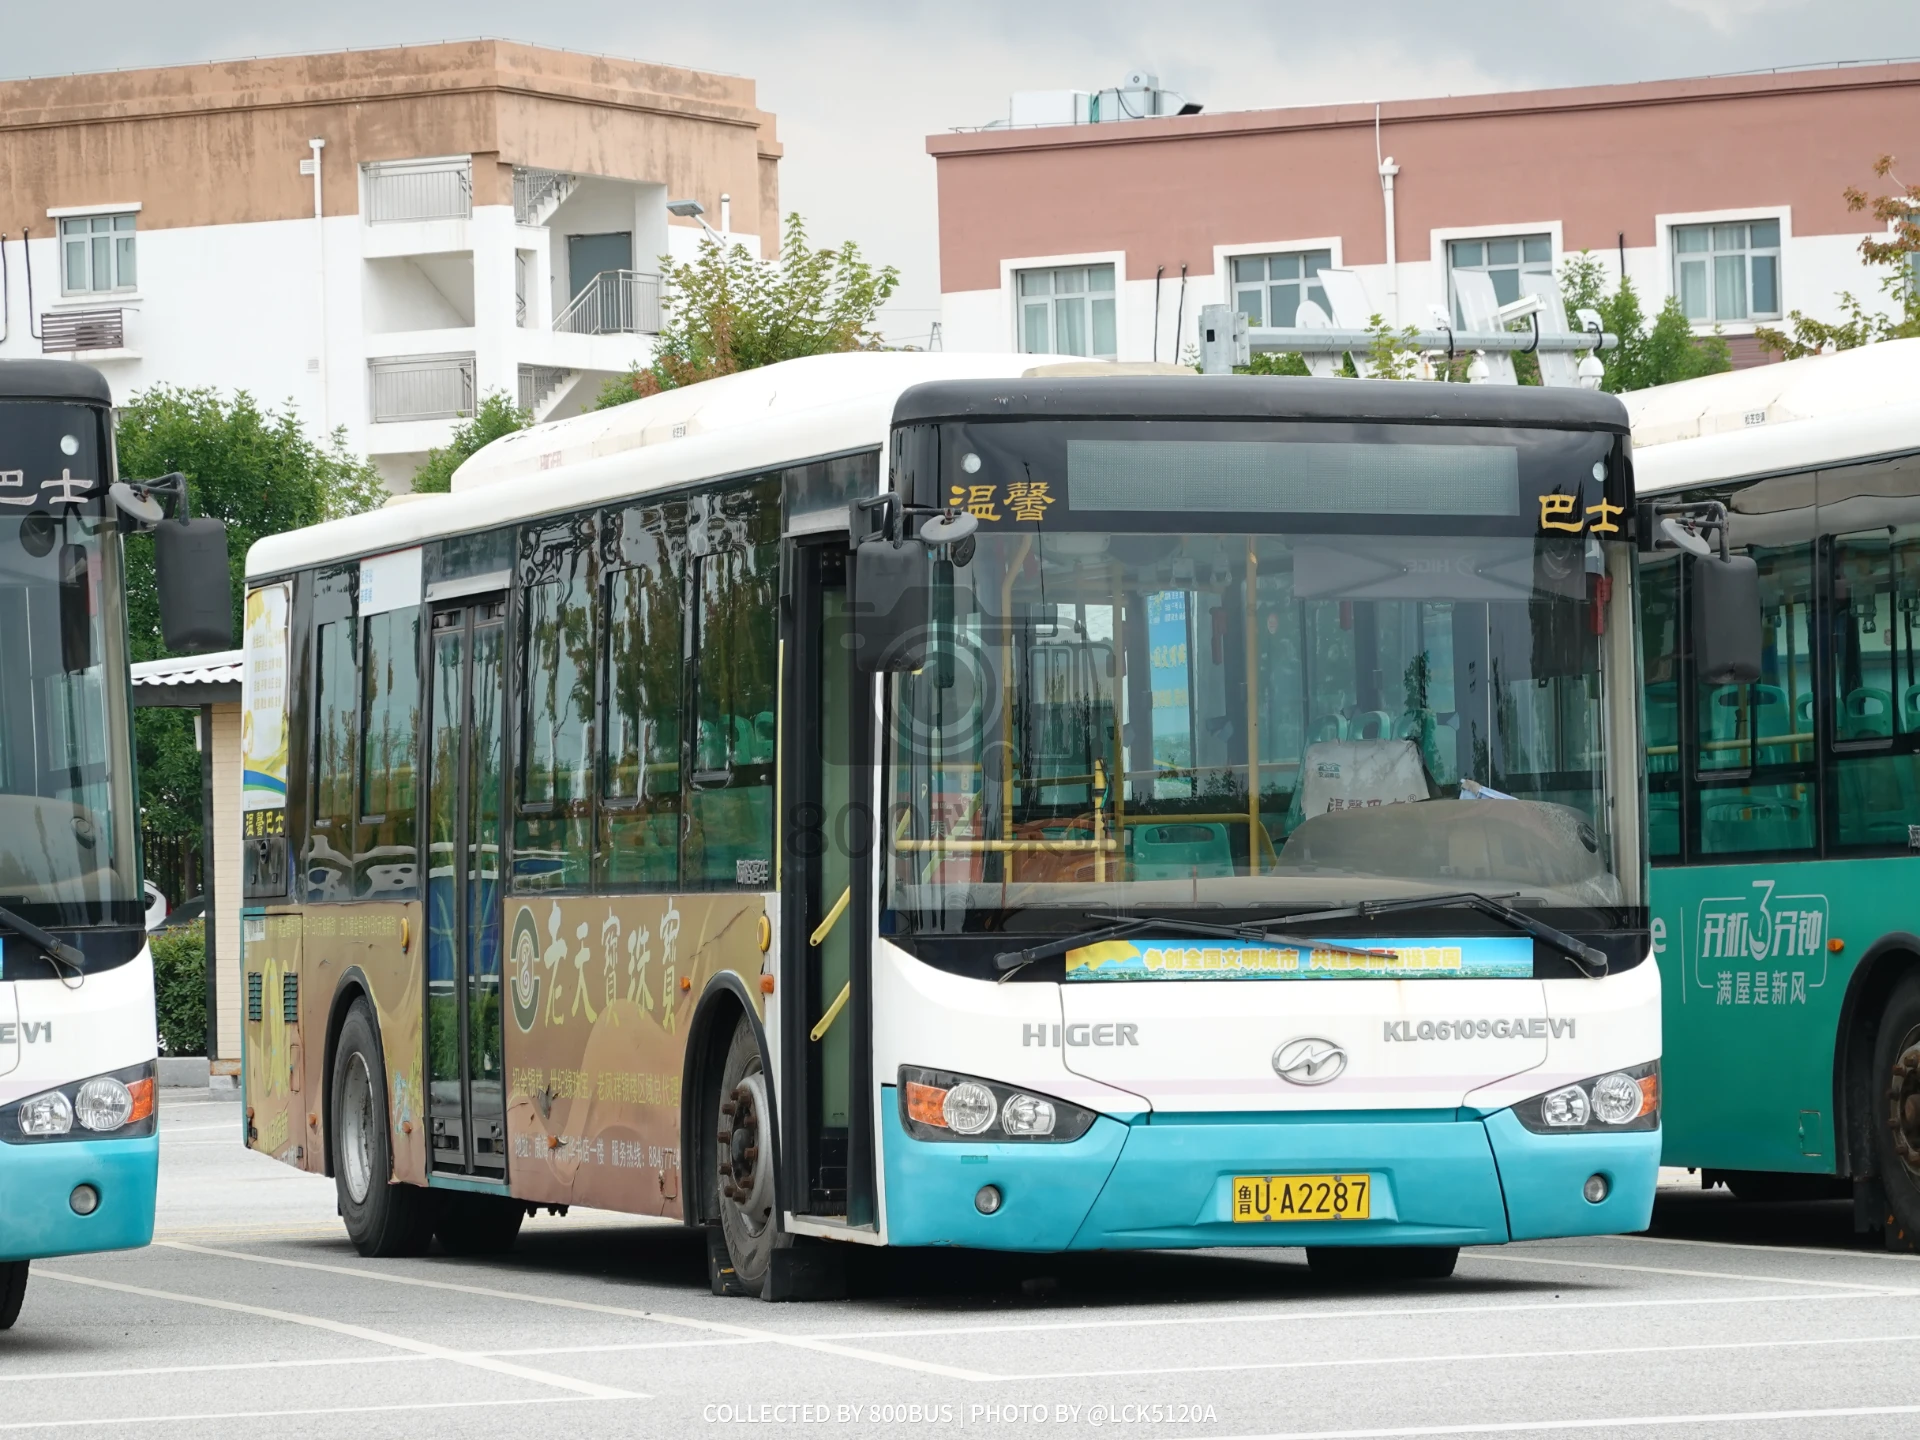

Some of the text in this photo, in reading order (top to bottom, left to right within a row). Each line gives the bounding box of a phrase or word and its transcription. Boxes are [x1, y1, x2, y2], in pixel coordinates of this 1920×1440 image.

[0, 468, 93, 506] 巴士
[949, 481, 1624, 532] 温馨 巴士
[245, 811, 284, 836] 温馨巴士
[1701, 880, 1823, 961] 开机3分钟
[1143, 947, 1299, 971] 争创全国文明城市
[1716, 970, 1806, 1005] 满屋是新风
[1022, 1023, 1139, 1047] HIGER
[1382, 1018, 1576, 1043] KLQ6109GAEV1
